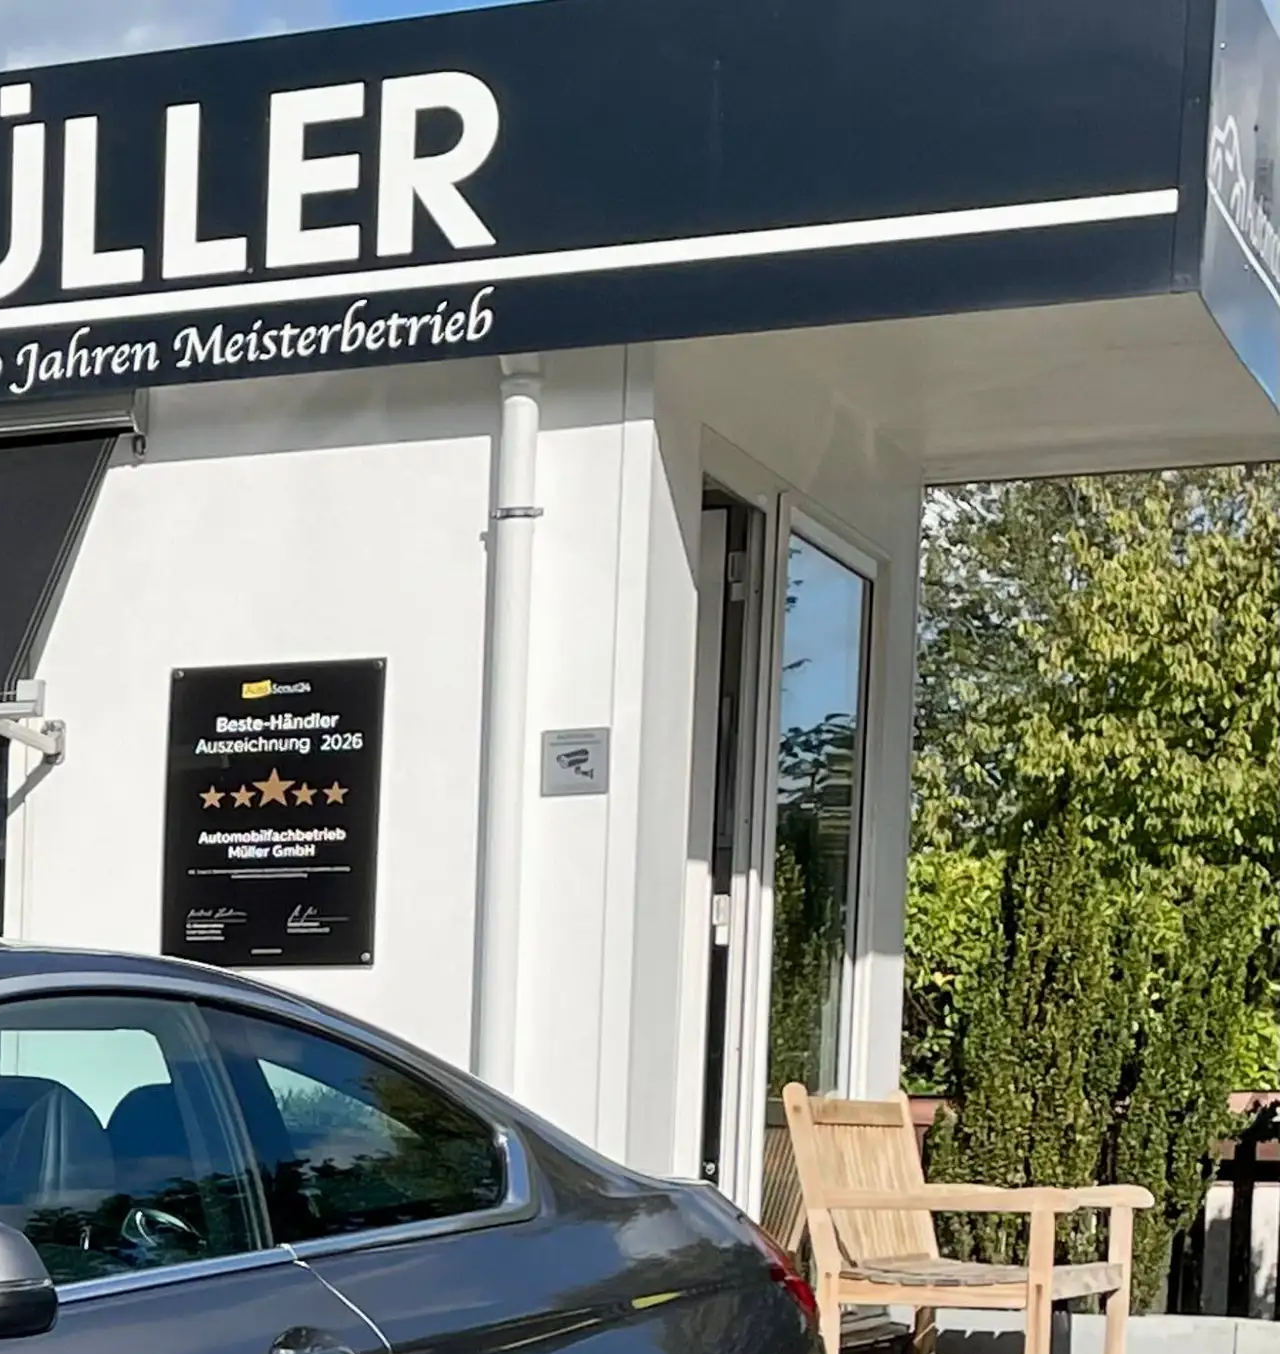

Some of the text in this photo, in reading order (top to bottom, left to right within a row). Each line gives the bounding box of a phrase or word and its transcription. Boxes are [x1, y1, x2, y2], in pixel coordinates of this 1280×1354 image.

[15, 328, 160, 395] Jahren
[172, 286, 496, 369] Meisterbetrieb
[216, 712, 339, 733] Beste-Händler
[195, 733, 364, 755] Auszeichnung 2026
[198, 827, 347, 845] Automobilfachbetrieb
[228, 843, 315, 859] Müller GmbH
